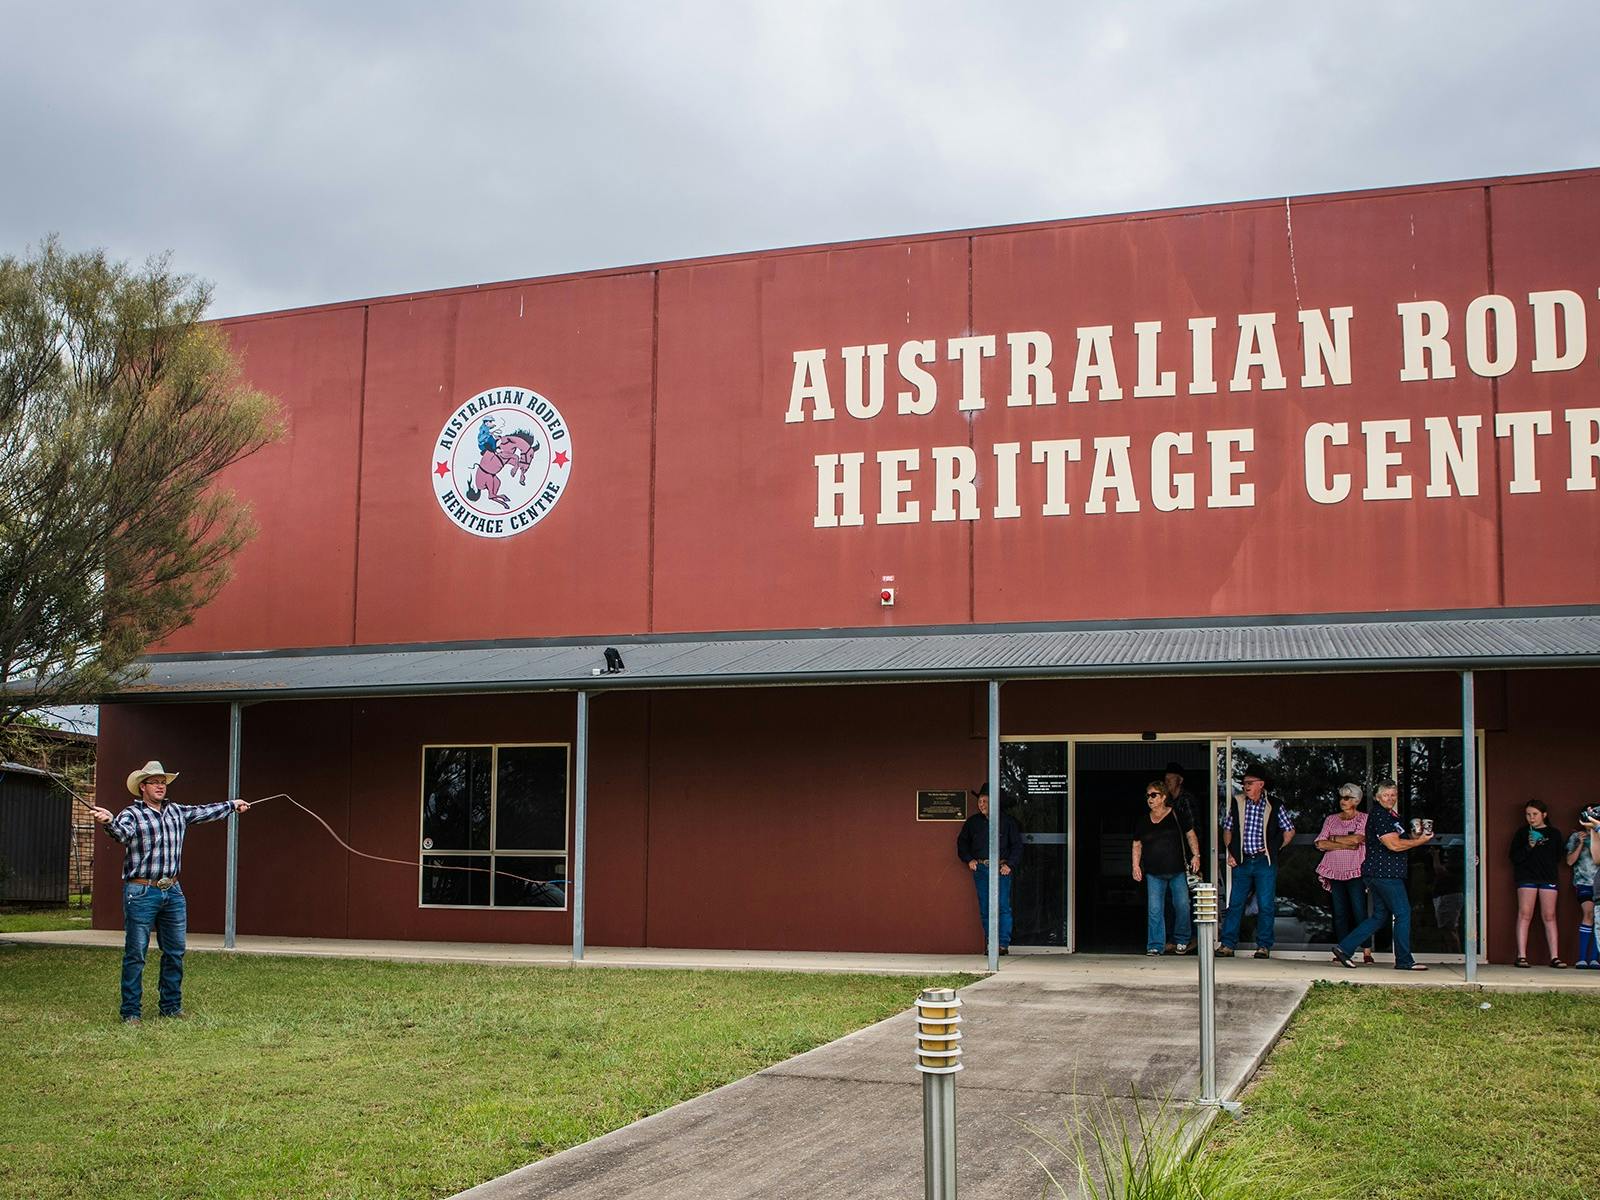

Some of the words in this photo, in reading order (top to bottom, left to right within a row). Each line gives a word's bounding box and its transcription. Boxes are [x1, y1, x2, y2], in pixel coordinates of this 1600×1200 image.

[785, 306, 1354, 423] AUSTRALIAN
[1397, 287, 1600, 382] ROD
[440, 390, 525, 450] AUSTRALIAN
[526, 396, 565, 440] RODEO
[442, 490, 504, 533] HERITAGE
[510, 481, 561, 530] CENTRE
[814, 428, 1256, 528] HERITAGE
